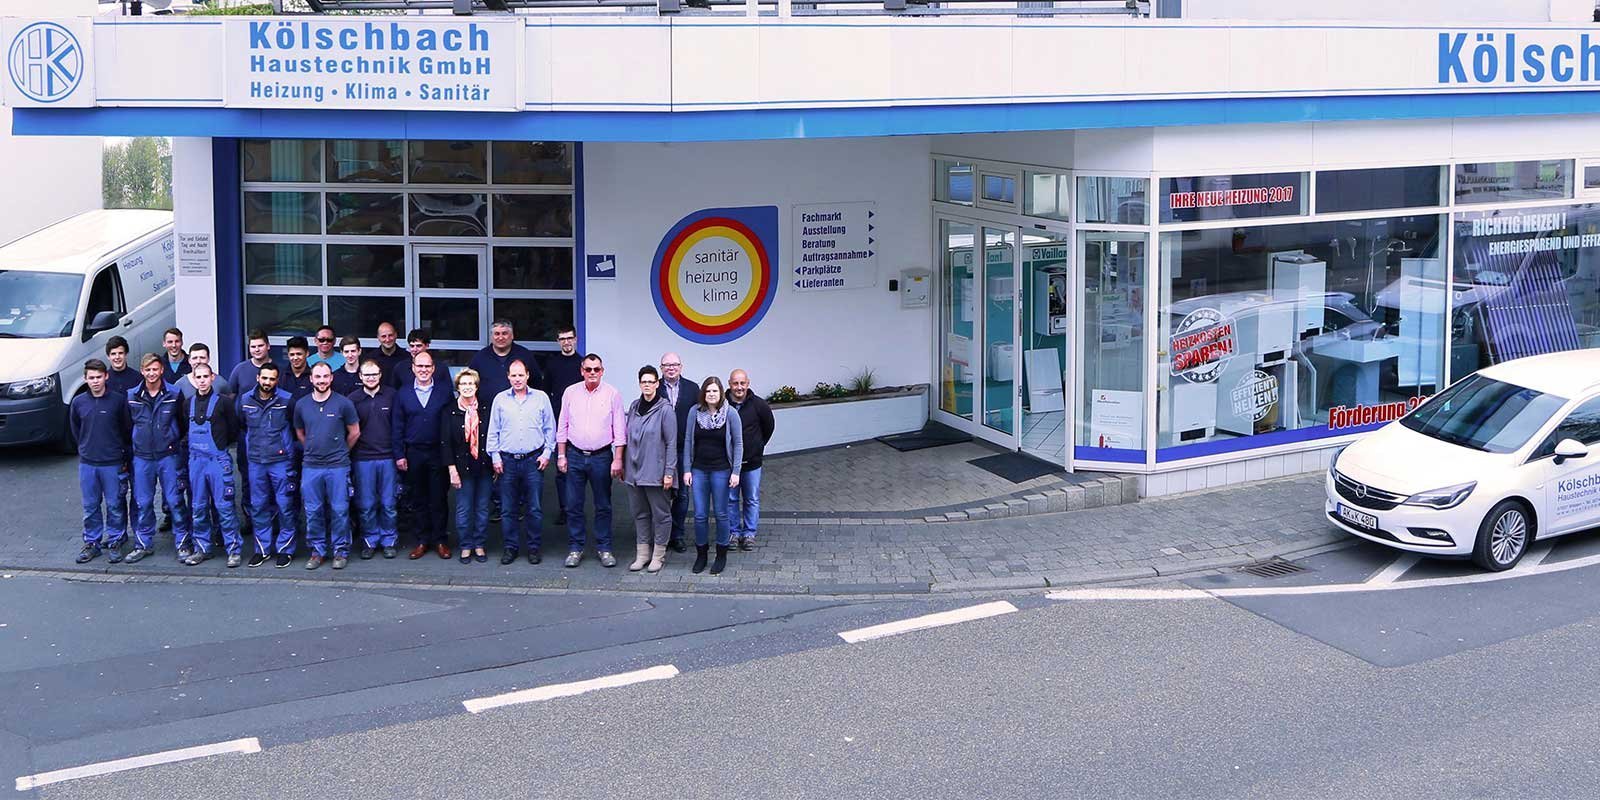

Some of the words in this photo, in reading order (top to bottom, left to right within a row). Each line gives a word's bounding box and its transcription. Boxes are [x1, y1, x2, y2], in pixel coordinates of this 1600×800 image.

[249, 22, 489, 51] Kölschbach
[250, 55, 411, 75] Haustechnik
[419, 56, 491, 75] GmbH
[1438, 32, 1600, 83] Kölsch
[250, 82, 324, 102] Heizung
[345, 83, 398, 100] Klima
[419, 83, 490, 101] Sanitär
[1170, 192, 1196, 209] IHRE
[1196, 190, 1223, 207] NEUE
[1224, 187, 1268, 206] HEIZUNG
[1268, 186, 1293, 203] 2017
[802, 212, 842, 222] Fachmarkt
[1472, 215, 1521, 237] RICHTIG
[1522, 213, 1560, 232] HEIZEN
[802, 225, 846, 236] Ausstellung
[802, 239, 836, 249] Beratung
[1489, 236, 1561, 256] ENERGIESPAREND
[1562, 234, 1580, 250] UND
[122, 255, 144, 270] Heizung
[695, 249, 739, 264] sanitär
[802, 250, 868, 262] Auftragsannahme
[685, 270, 738, 285] heizung
[802, 265, 842, 276] Parkplätze
[802, 278, 844, 288] Lieferanten
[703, 288, 738, 302] klima
[1172, 324, 1231, 352] HEIZKOSTEN
[1174, 339, 1233, 371] SPAREN!
[1232, 378, 1276, 401] EFFIZIENT
[1233, 387, 1278, 415] HEIZEN!
[1328, 402, 1405, 430] Förderung
[1557, 487, 1597, 503] Haustechnik
